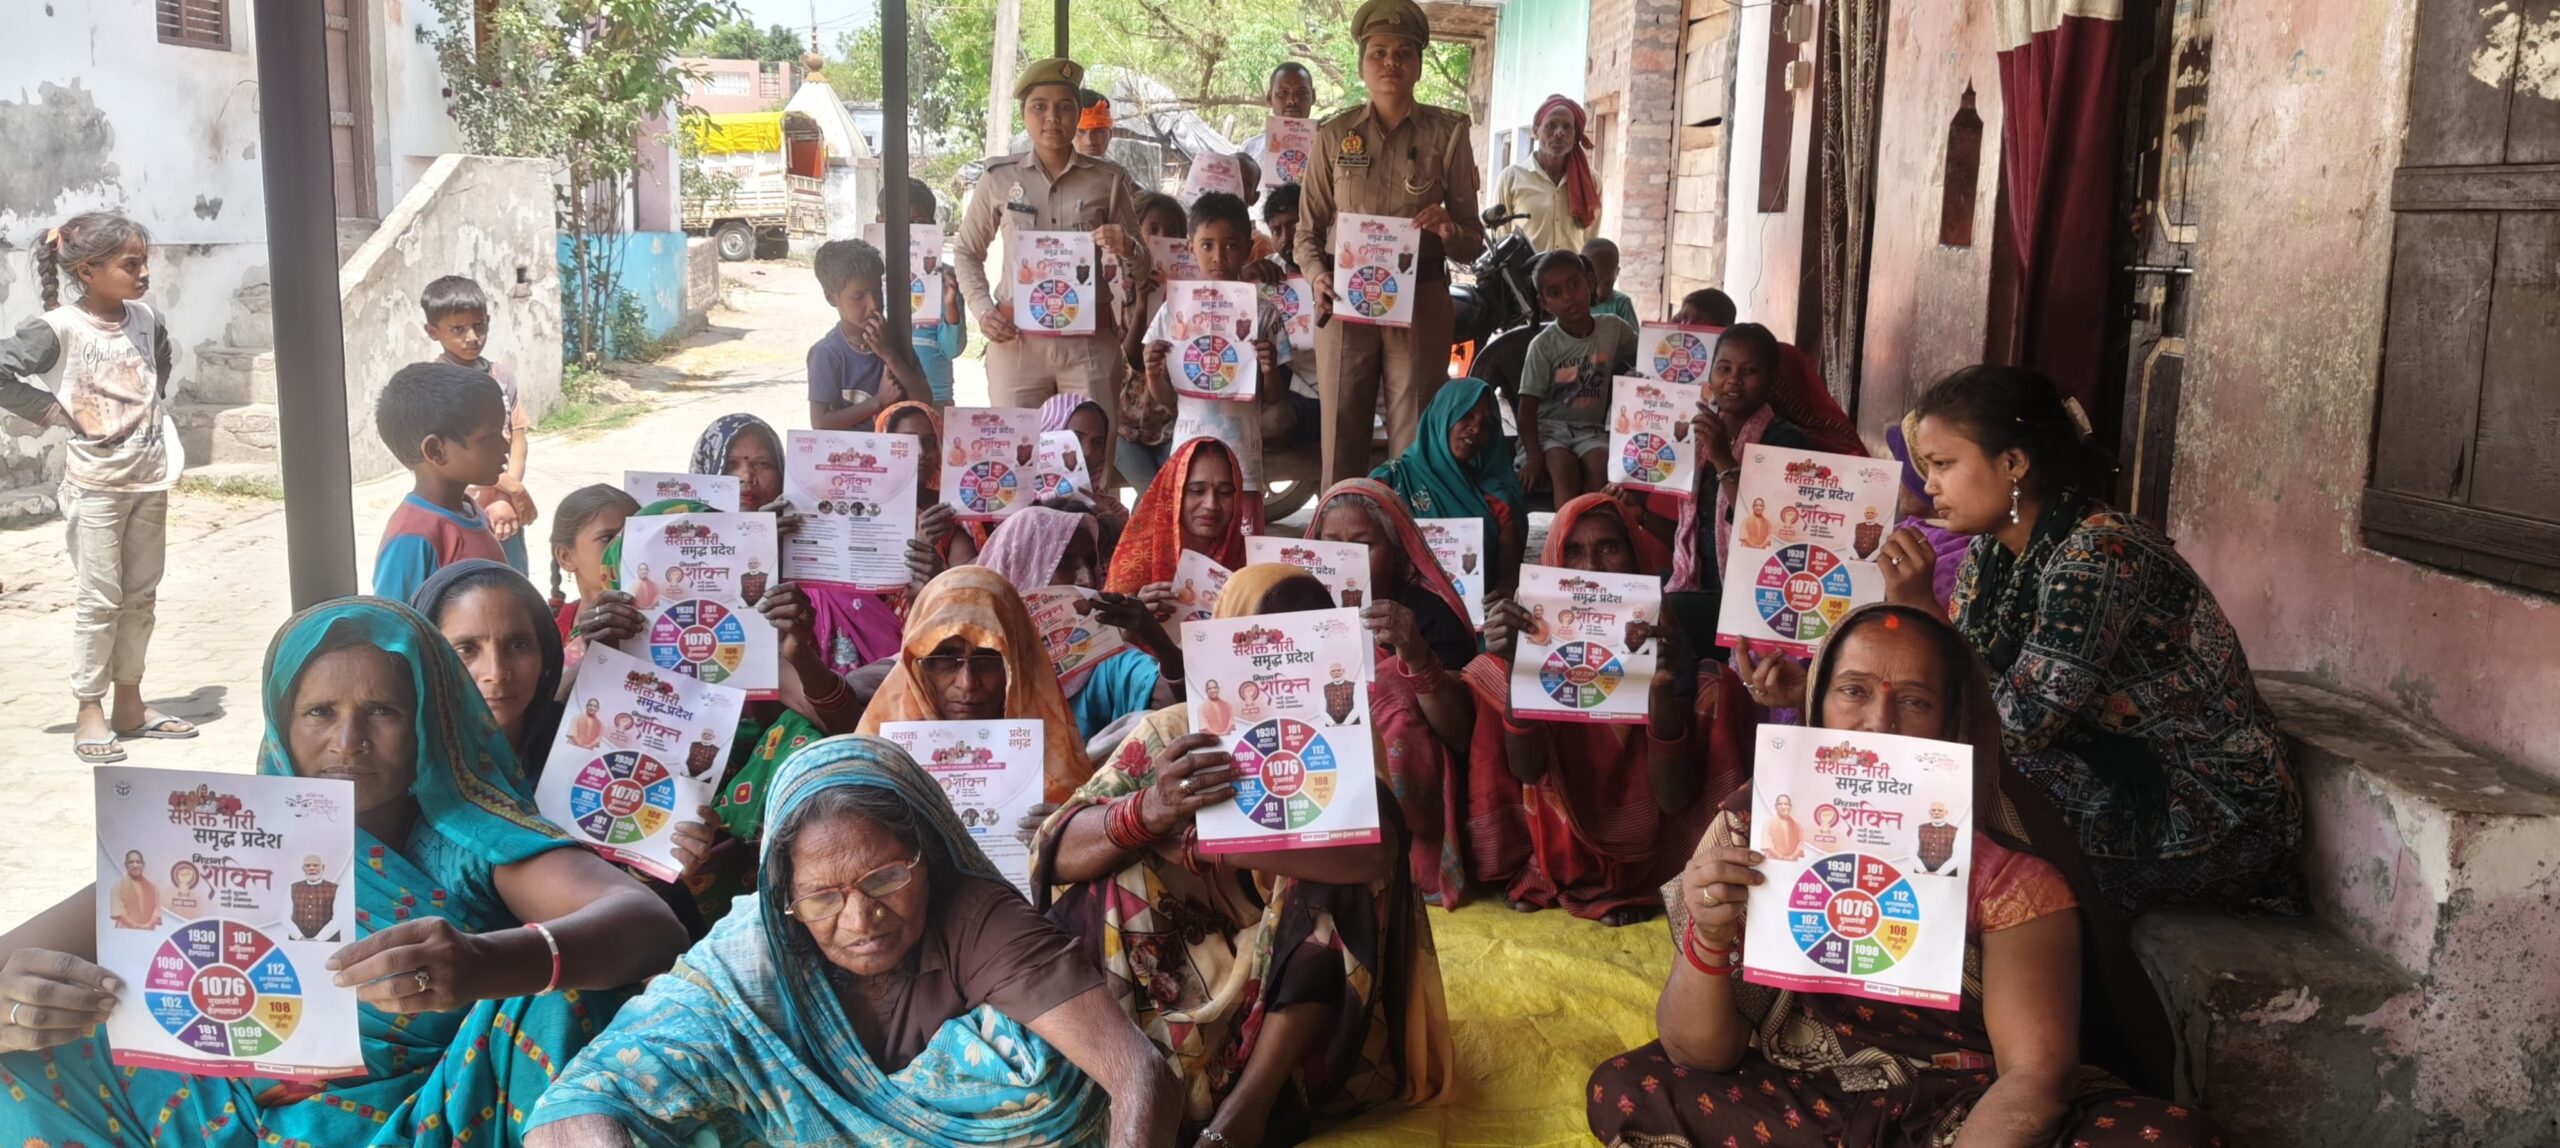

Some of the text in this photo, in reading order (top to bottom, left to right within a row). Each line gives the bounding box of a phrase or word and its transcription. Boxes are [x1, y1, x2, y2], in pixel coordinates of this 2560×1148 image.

[1790, 580, 1817, 594] 1076
[684, 633, 712, 645] 1076
[1251, 649, 1314, 670] समृद्ध प्रदेश
[1009, 727, 1031, 738] प्रदेश
[1008, 738, 1031, 750] समृद्ध
[1266, 760, 1299, 776] 1076
[1862, 762, 1890, 779] नारी
[610, 784, 642, 801] 1076
[1835, 777, 1913, 797] समृद्ध प्रदेश
[222, 809, 256, 830] नारी
[1840, 801, 1904, 837] शक्ति
[193, 828, 283, 850] समृद्ध प्रदेश
[1826, 860, 1852, 872] 1930
[1866, 863, 1883, 875] 101
[200, 855, 272, 900] शक्ति
[1797, 882, 1823, 894] 1090
[1892, 890, 1909, 902] 112
[1834, 898, 1874, 918] 1076
[1801, 914, 1818, 925] 102
[187, 929, 216, 943] 1930
[1889, 924, 1907, 936] 108
[232, 931, 253, 945] 101
[1825, 941, 1842, 952] 181
[1854, 944, 1880, 956] 1098
[156, 956, 184, 970] 1090
[266, 963, 286, 976] 112
[200, 977, 247, 997] 1076
[160, 996, 182, 1009] 102
[269, 1002, 291, 1013] 108
[198, 1024, 217, 1036] 181
[231, 1026, 262, 1038] 1098
